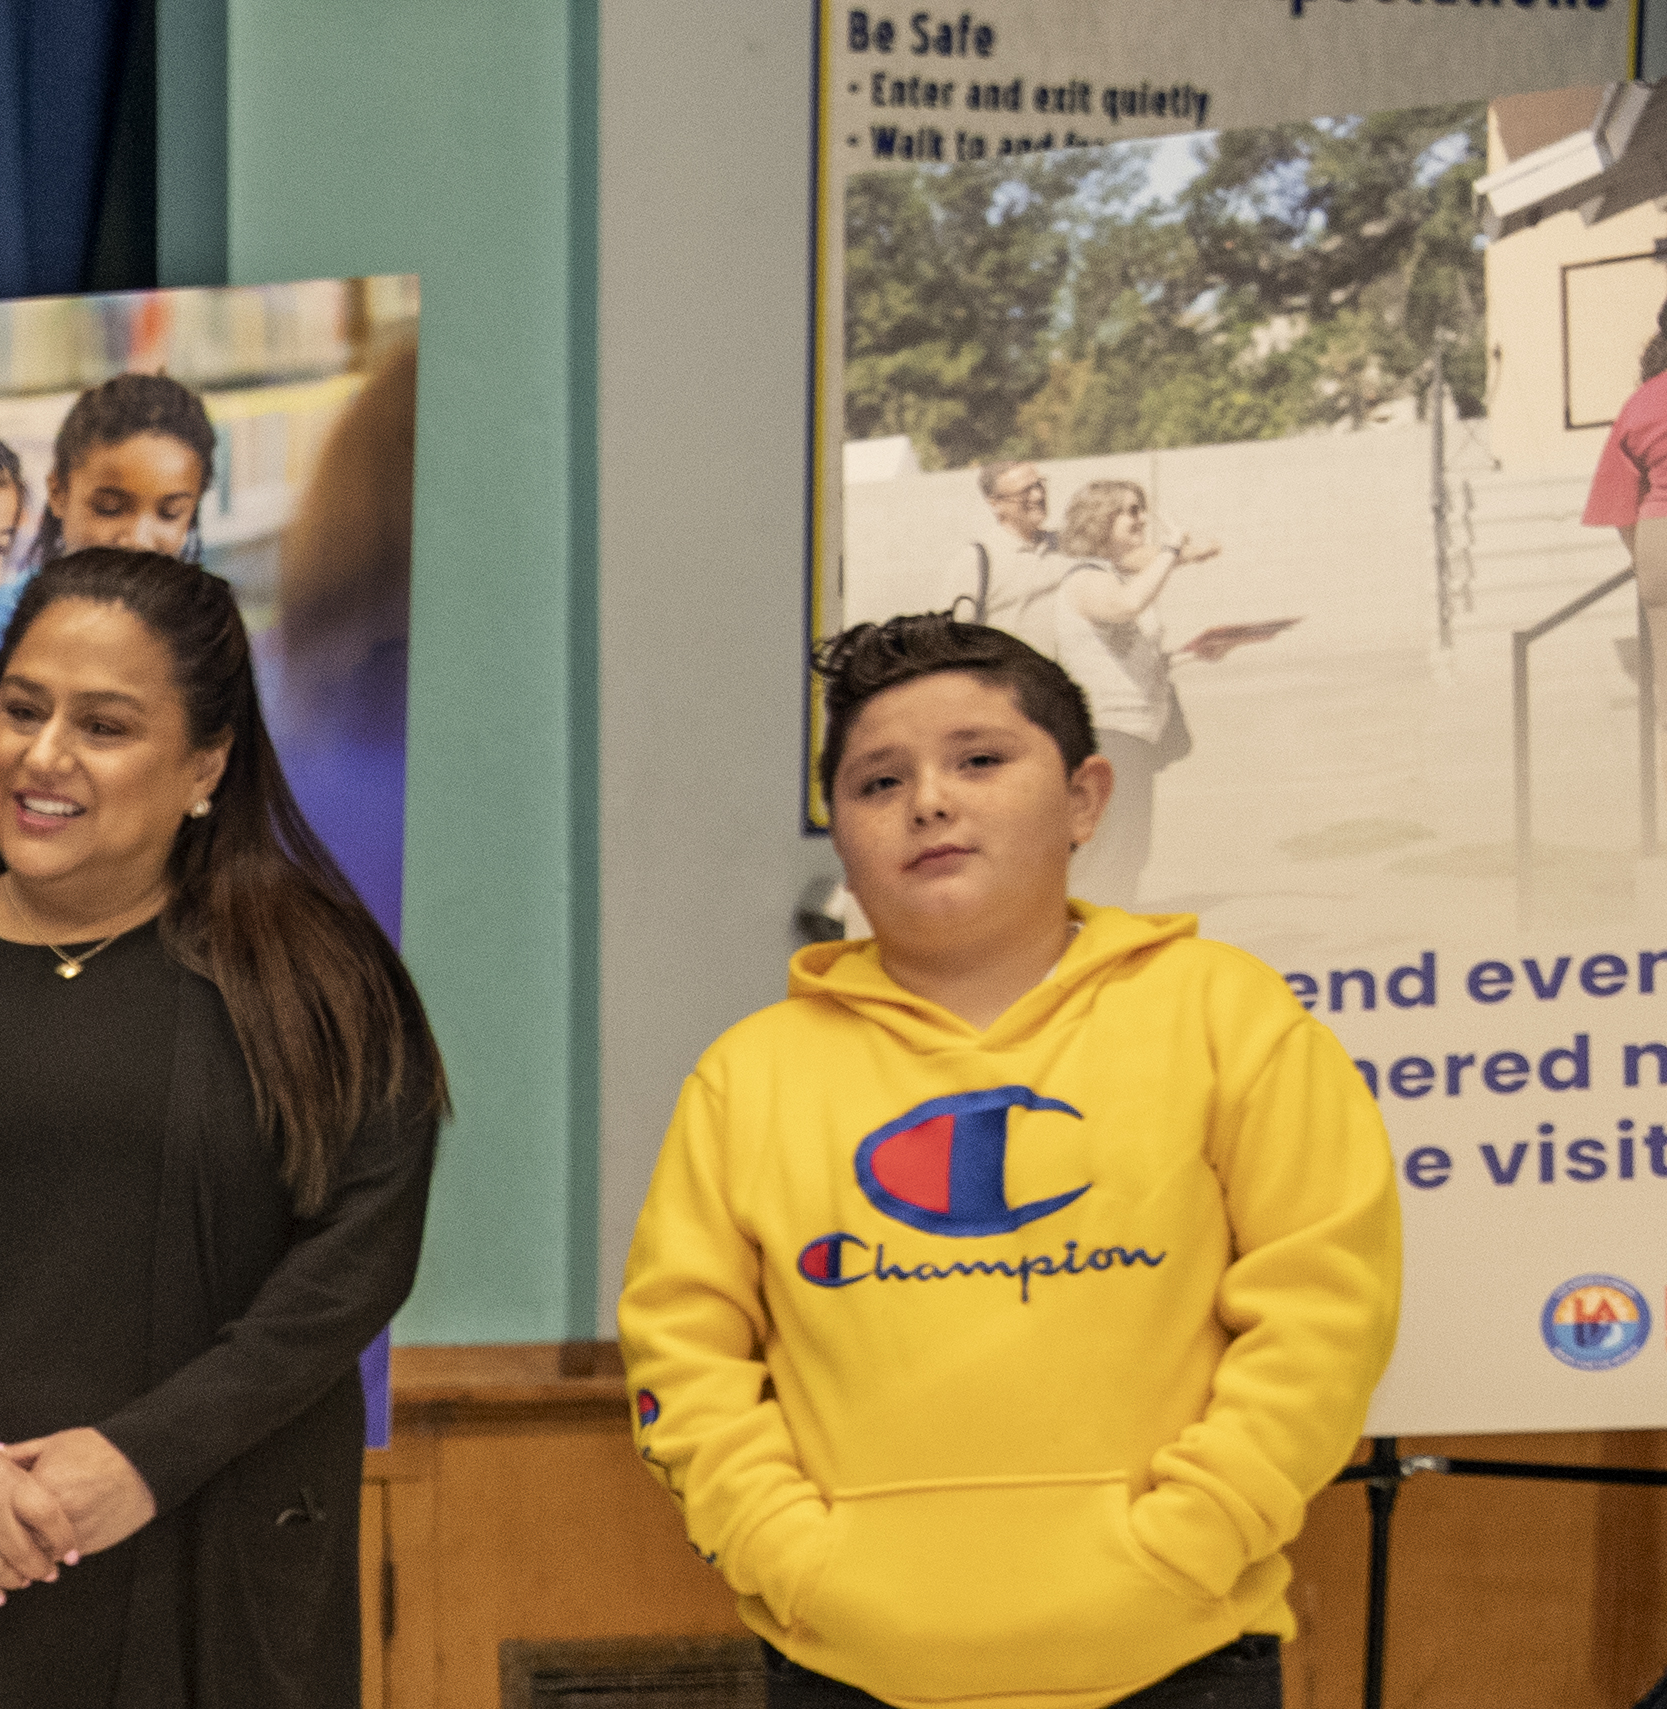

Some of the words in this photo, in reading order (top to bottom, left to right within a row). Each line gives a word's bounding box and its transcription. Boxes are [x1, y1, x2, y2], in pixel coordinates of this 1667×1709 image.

[850, 10, 895, 54] Be
[910, 11, 996, 58] Safe
[871, 72, 955, 108] Enter
[969, 80, 1021, 113] and
[1032, 80, 1091, 114] exit
[1103, 83, 1211, 128] quietly
[871, 125, 943, 161] Walk
[1479, 1119, 1667, 1187] visit
[797, 1232, 1166, 1302] Champion
